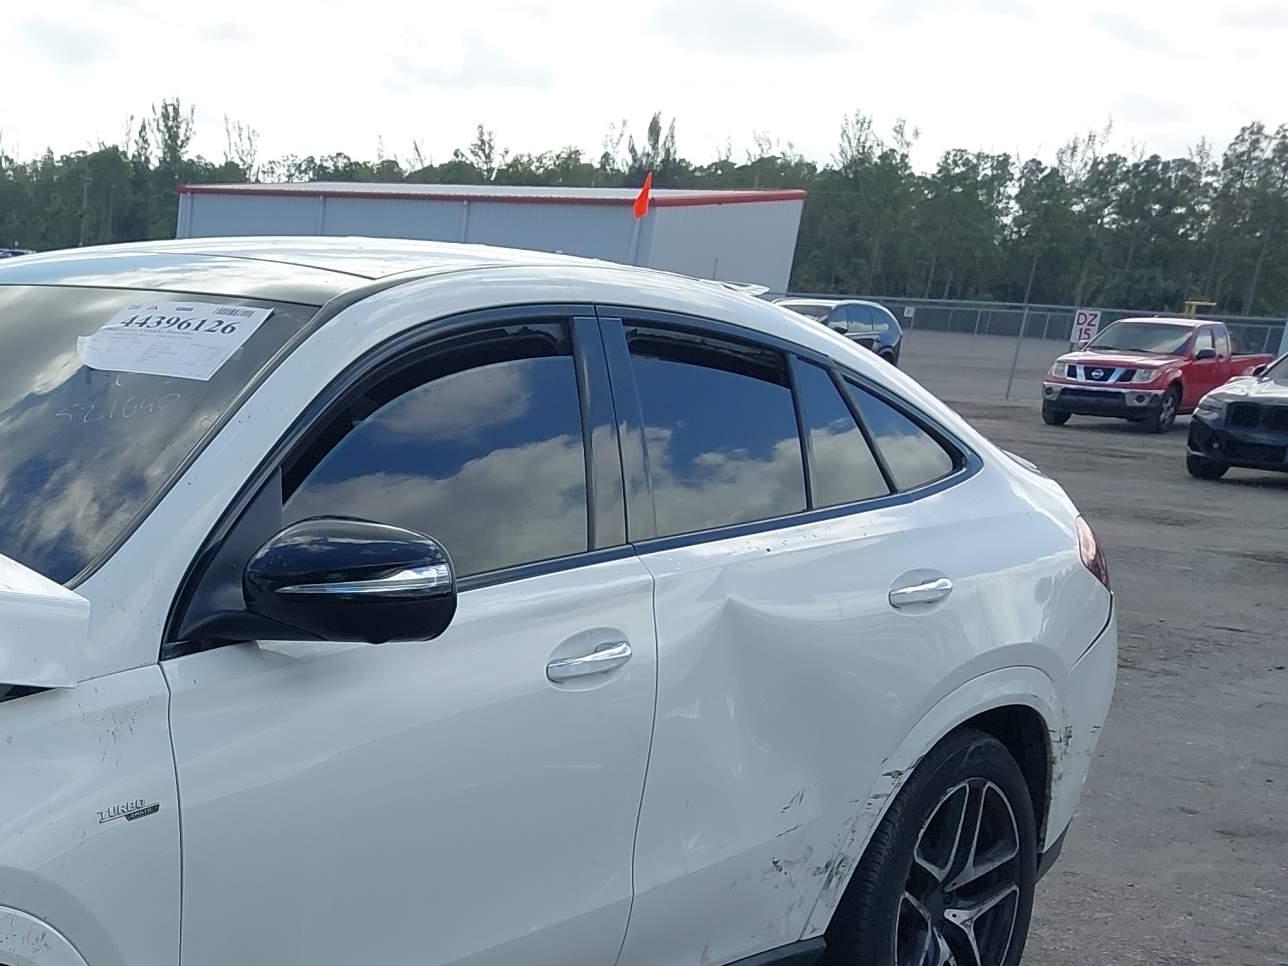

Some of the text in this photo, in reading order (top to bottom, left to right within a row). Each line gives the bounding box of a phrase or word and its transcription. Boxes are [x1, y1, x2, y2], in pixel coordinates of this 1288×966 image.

[120, 313, 240, 335] 44396126
[1076, 311, 1098, 327] DZ
[1078, 327, 1091, 341] 15
